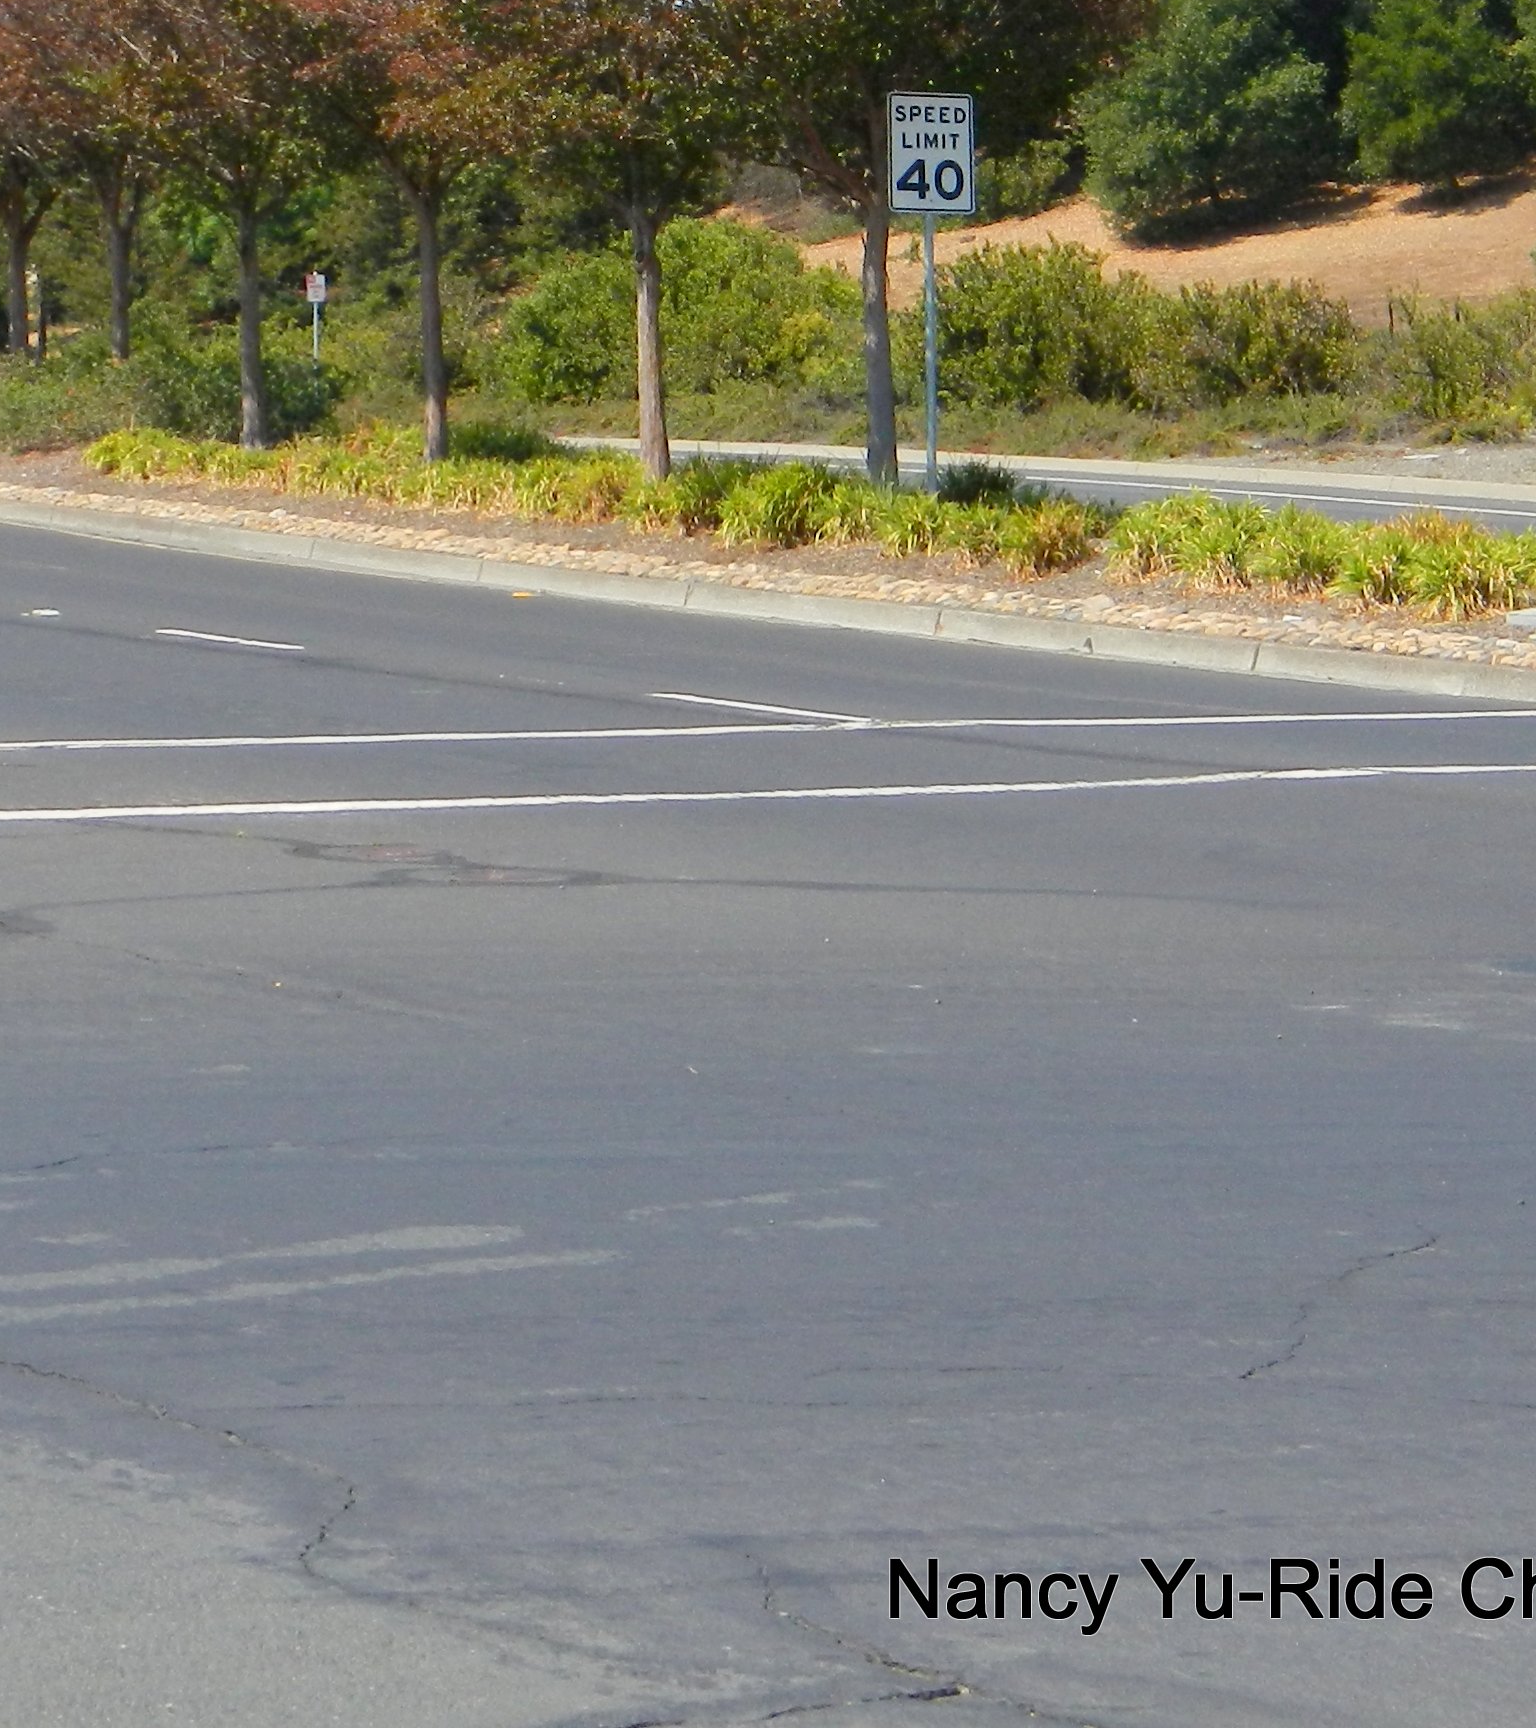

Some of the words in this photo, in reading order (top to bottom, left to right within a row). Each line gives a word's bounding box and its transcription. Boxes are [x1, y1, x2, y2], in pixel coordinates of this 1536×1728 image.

[895, 105, 967, 124] SPEED
[902, 132, 960, 150] LIMIT
[896, 158, 964, 201] 40
